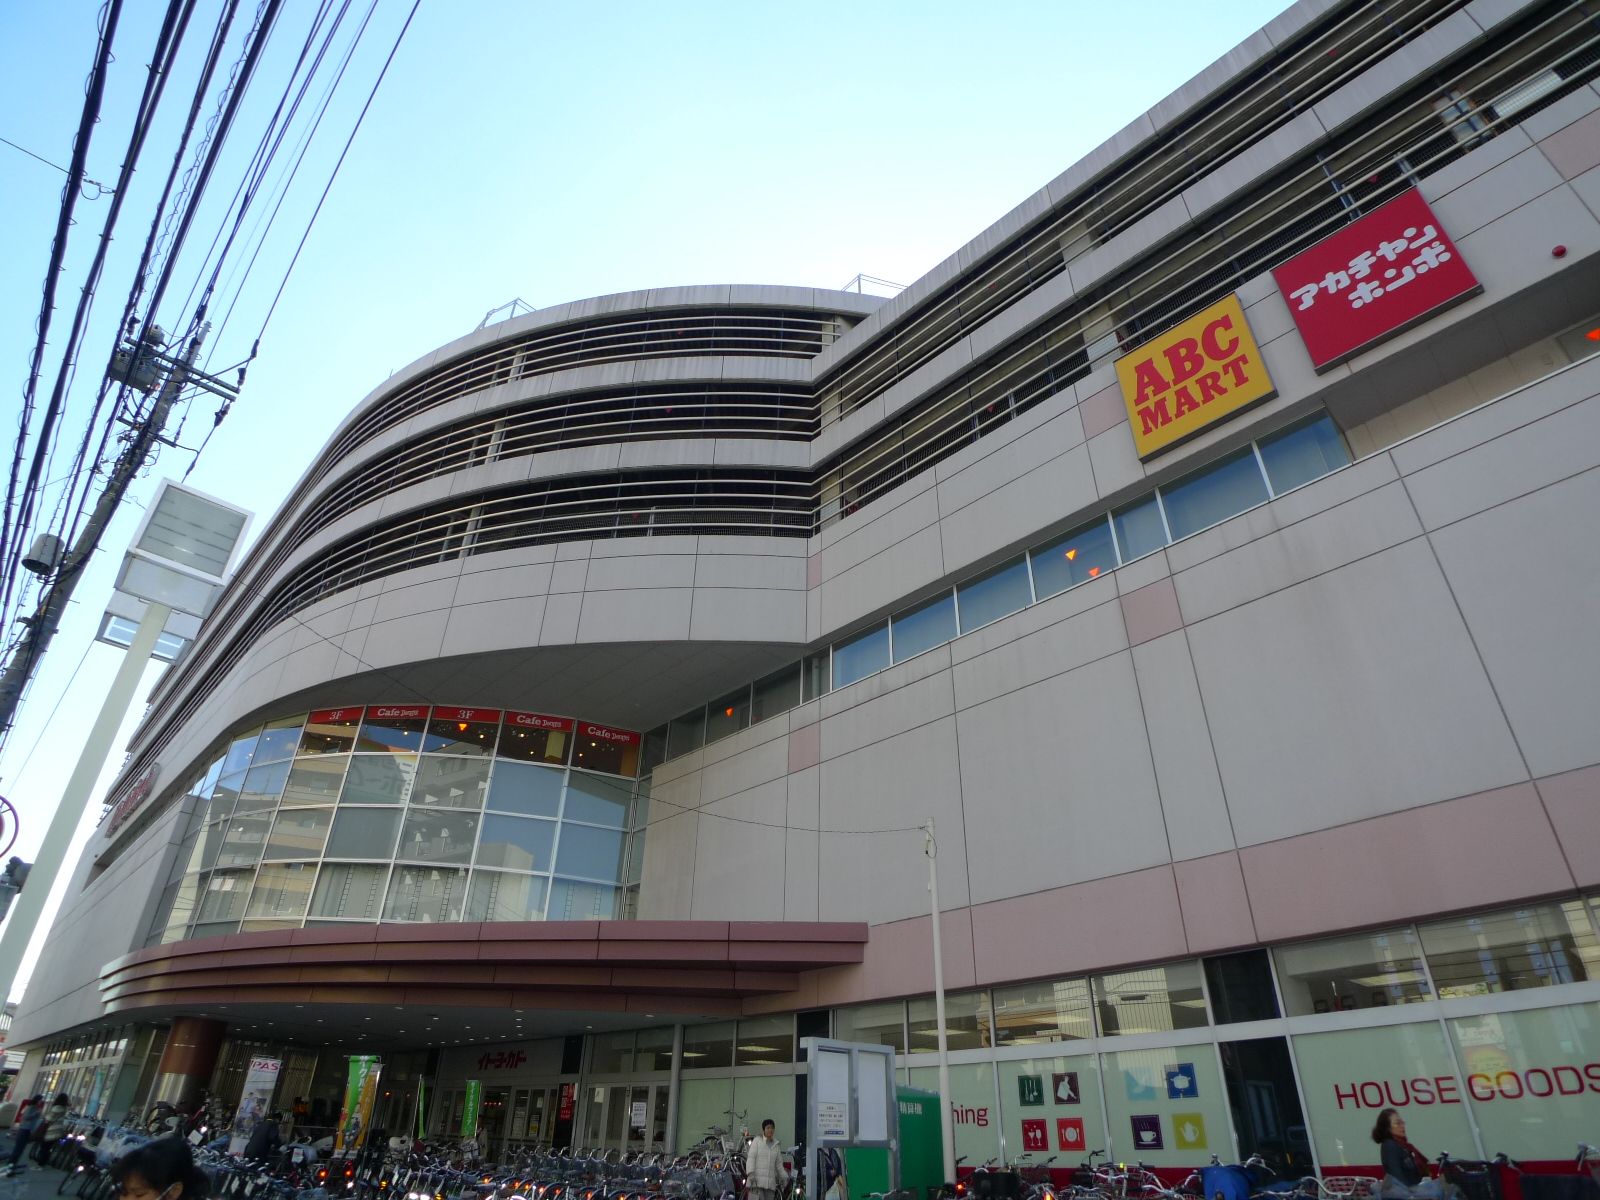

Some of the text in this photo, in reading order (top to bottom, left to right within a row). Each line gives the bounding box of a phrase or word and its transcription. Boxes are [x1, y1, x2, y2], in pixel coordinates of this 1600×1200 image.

[1348, 241, 1451, 308] ホンポ
[1134, 314, 1239, 406] ABC
[1137, 354, 1249, 436] MART
[329, 710, 344, 721] 3F
[377, 708, 401, 717] Cafe
[457, 710, 475, 719] 3F
[516, 715, 542, 726] Cafe
[587, 726, 611, 740] Cafe
[252, 1061, 280, 1071] PAS
[1334, 1063, 1600, 1111] HOUSE GOODS
